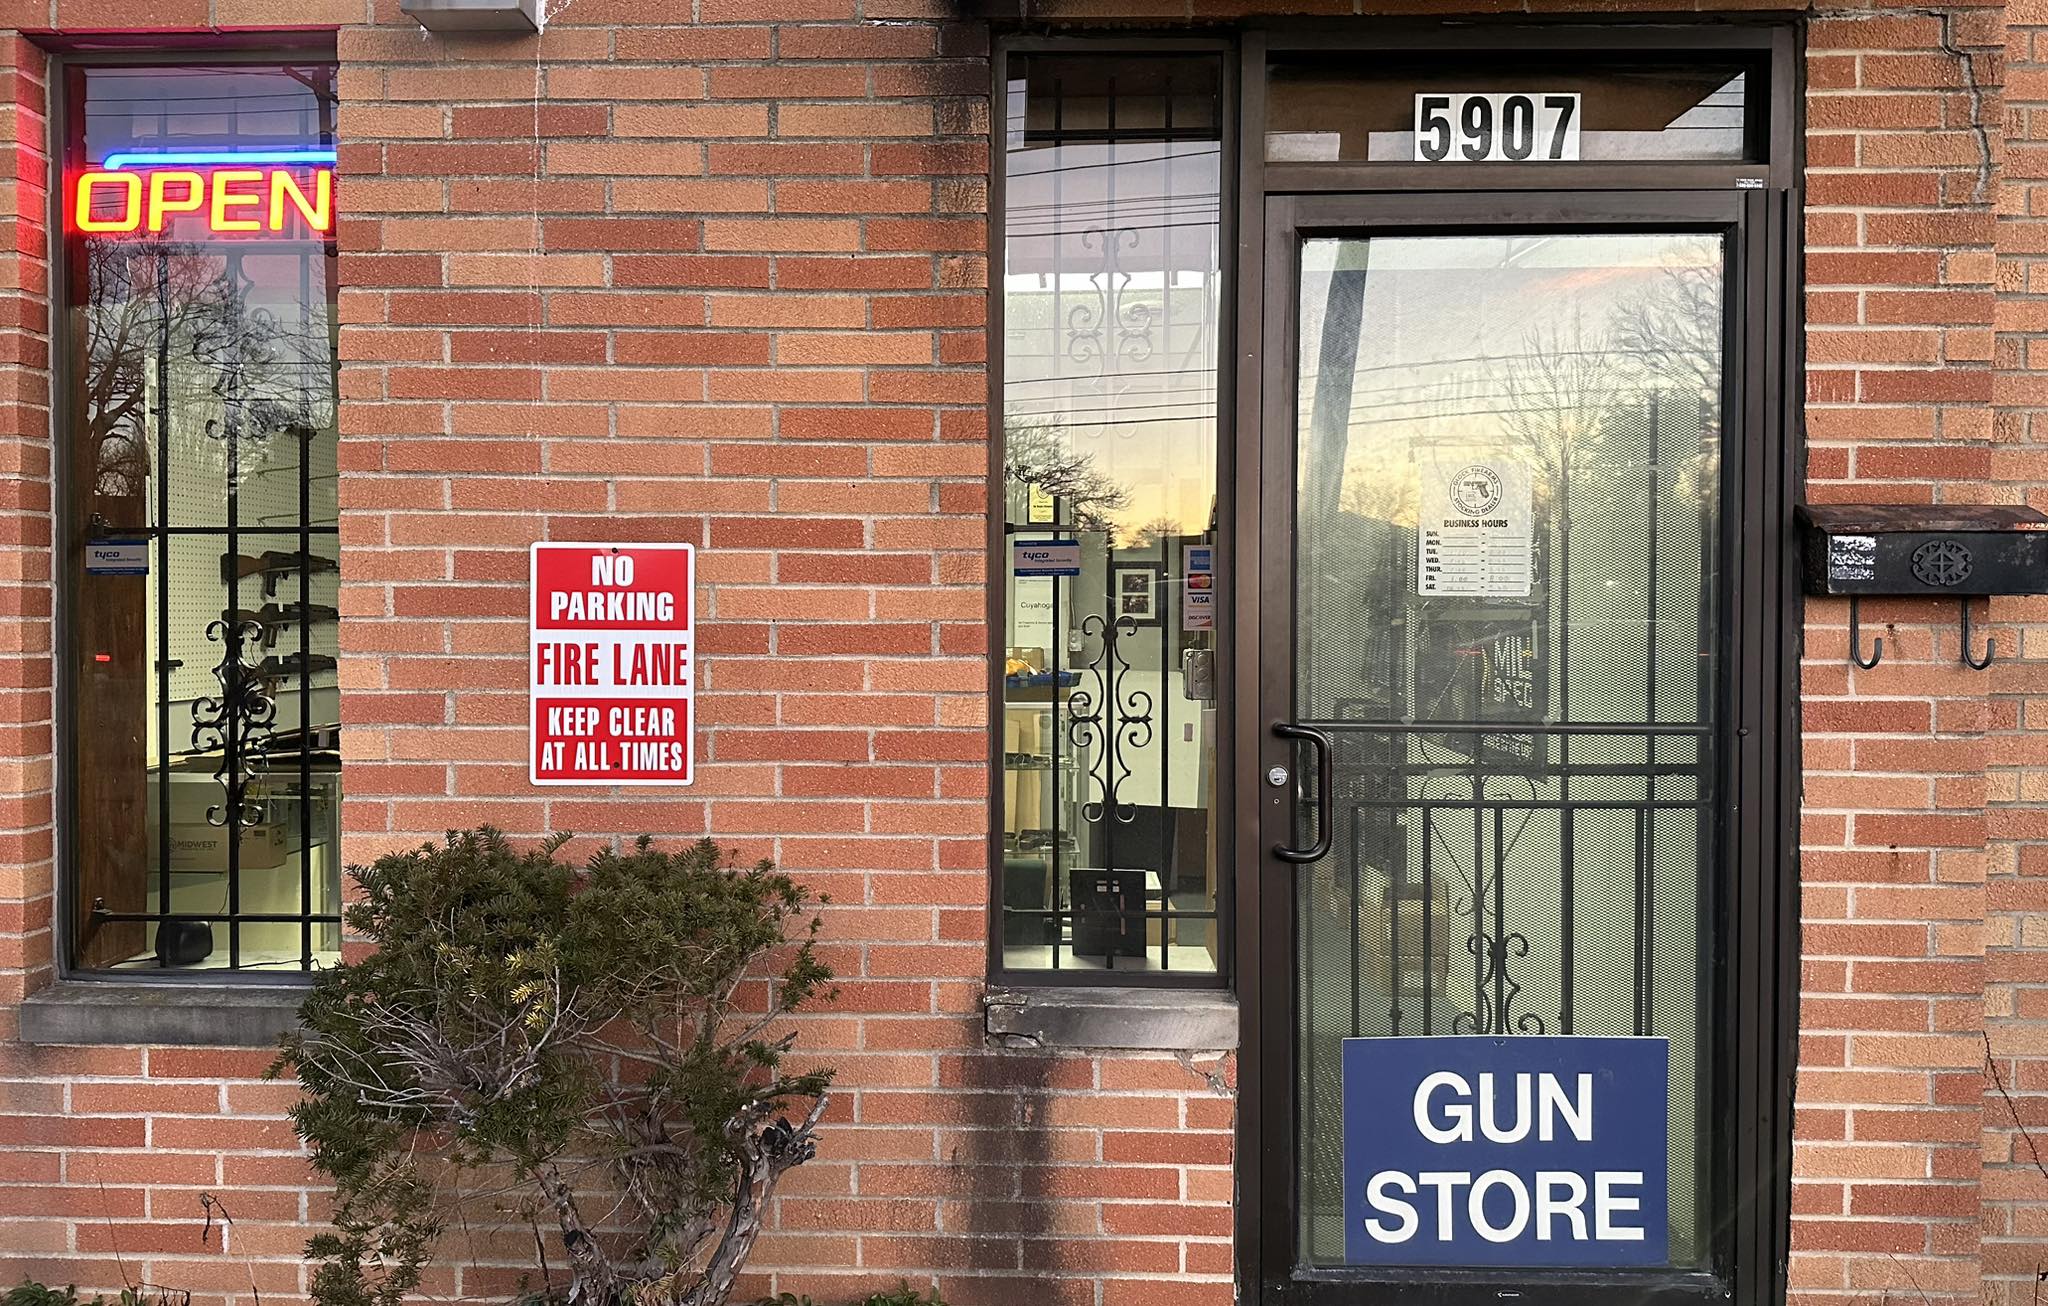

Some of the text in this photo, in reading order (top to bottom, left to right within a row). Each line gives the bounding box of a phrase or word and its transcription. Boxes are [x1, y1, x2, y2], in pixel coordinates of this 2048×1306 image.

[1419, 95, 1576, 161] 5907
[75, 170, 332, 232] OPEN
[1471, 468, 1499, 485] FIREARMS
[1454, 497, 1480, 514] STOCKING
[1481, 496, 1499, 514] DEALER
[1443, 519, 1508, 528] BUSINESS HOURS
[94, 550, 120, 560] tyco
[1022, 551, 1050, 560] tyco
[591, 555, 634, 587] NO
[550, 591, 675, 622] PARKING
[1191, 596, 1210, 604] VISA
[536, 642, 687, 686] FIRE LANE
[1494, 636, 1533, 681] MIL
[548, 706, 675, 737] KEEP CLEAR
[541, 741, 683, 772] AT ALL TIMES
[176, 840, 217, 849] MIDWEST
[1413, 1071, 1593, 1144] GUN
[1364, 1169, 1645, 1244] STORE
